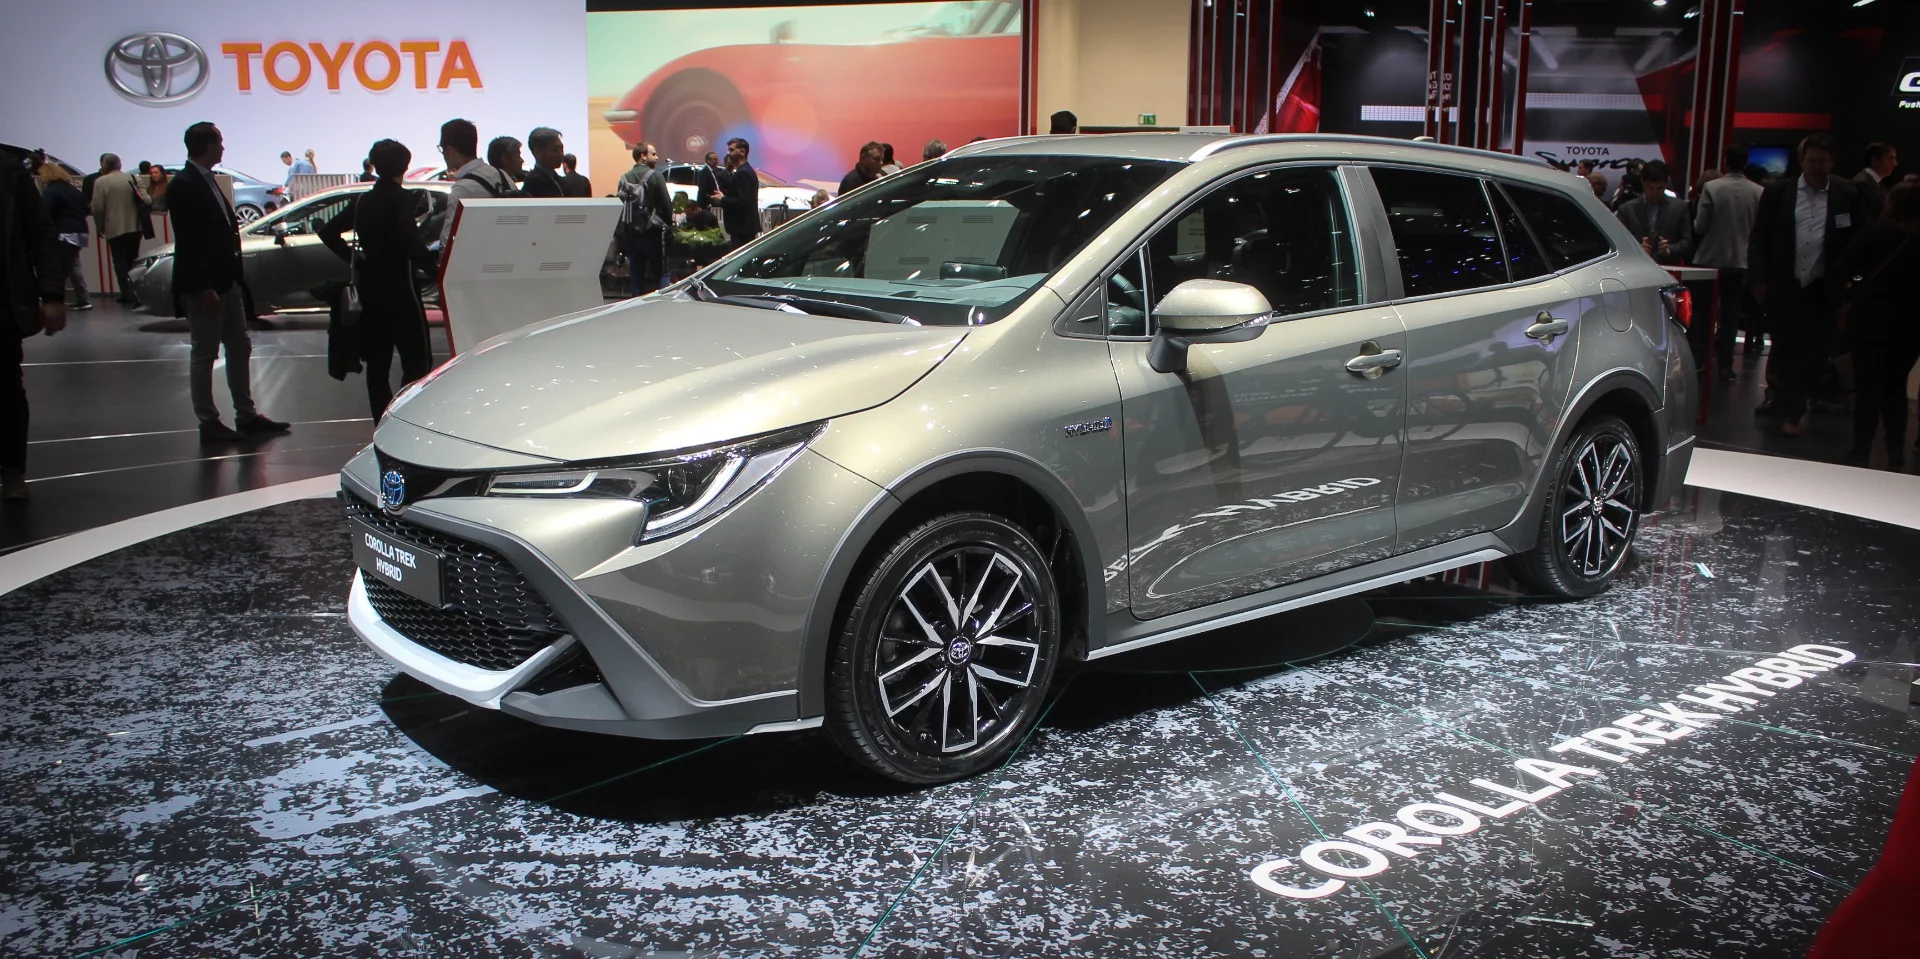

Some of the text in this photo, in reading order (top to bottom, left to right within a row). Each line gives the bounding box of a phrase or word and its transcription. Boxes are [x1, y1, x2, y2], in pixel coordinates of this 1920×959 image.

[221, 41, 483, 91] TOYOTA
[1566, 146, 1610, 155] TOYOTA
[365, 532, 416, 569] COROLLA TREK
[376, 557, 402, 582] HYBRID
[1250, 643, 1857, 900] COROLLA TREK HYBRID
